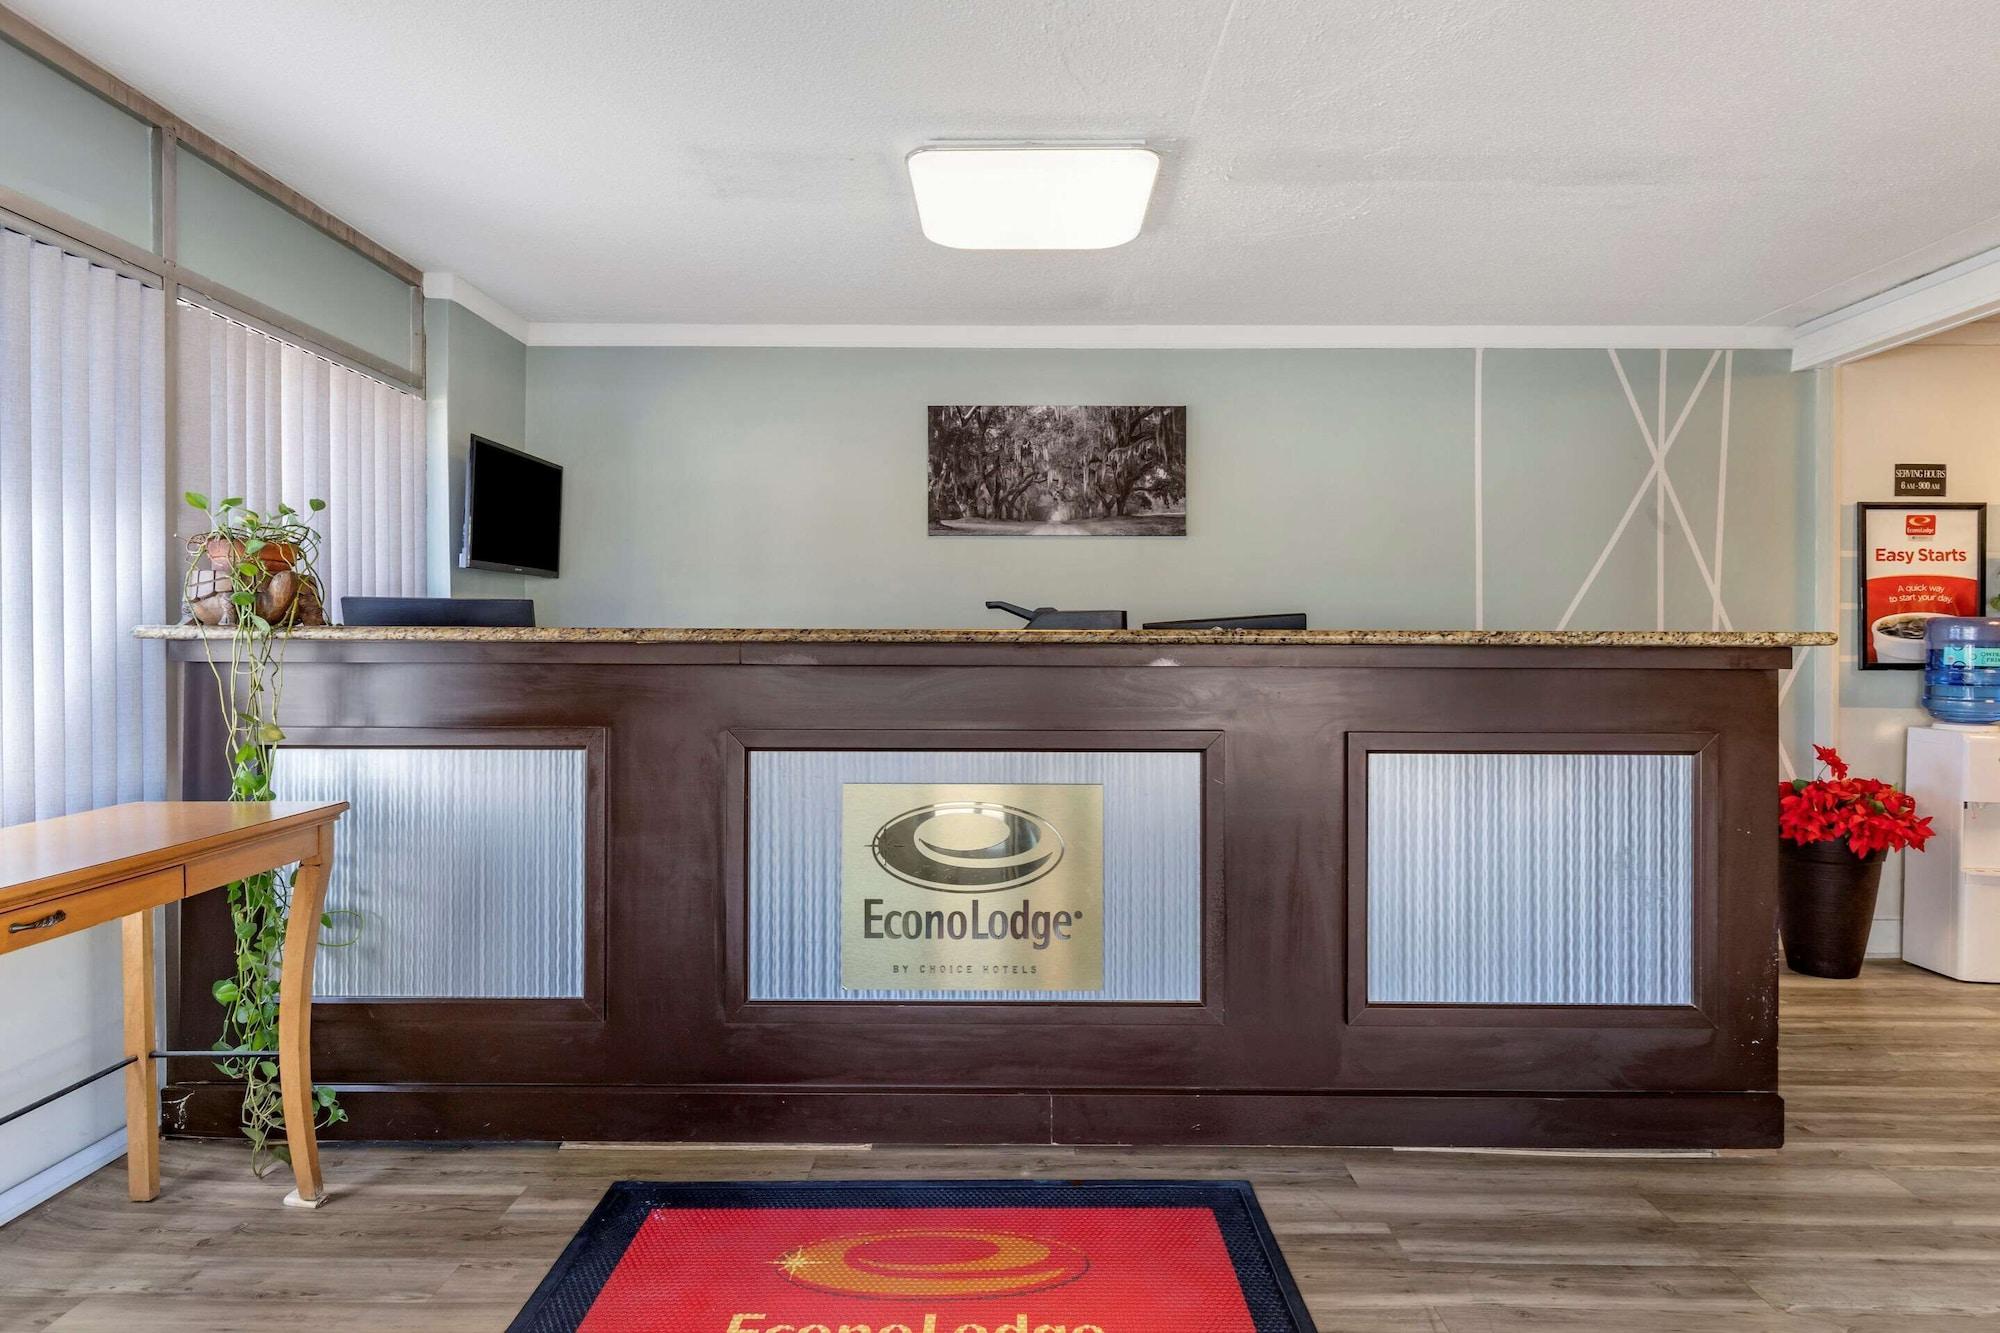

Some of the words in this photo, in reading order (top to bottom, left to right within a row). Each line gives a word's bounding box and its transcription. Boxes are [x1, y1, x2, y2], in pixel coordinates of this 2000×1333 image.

[1895, 470, 1923, 478] SERVING
[1924, 470, 1946, 478] HOURS
[1875, 548, 1914, 564] Easy
[1918, 548, 1967, 562] Starts
[1905, 584, 1928, 593] quick
[1928, 585, 1945, 594] way
[1899, 594, 1917, 602] start
[863, 898, 1073, 950] EconoLodge
[892, 964, 909, 974] BY
[919, 964, 973, 974] CHOICE
[982, 964, 1038, 975] HOTELS
